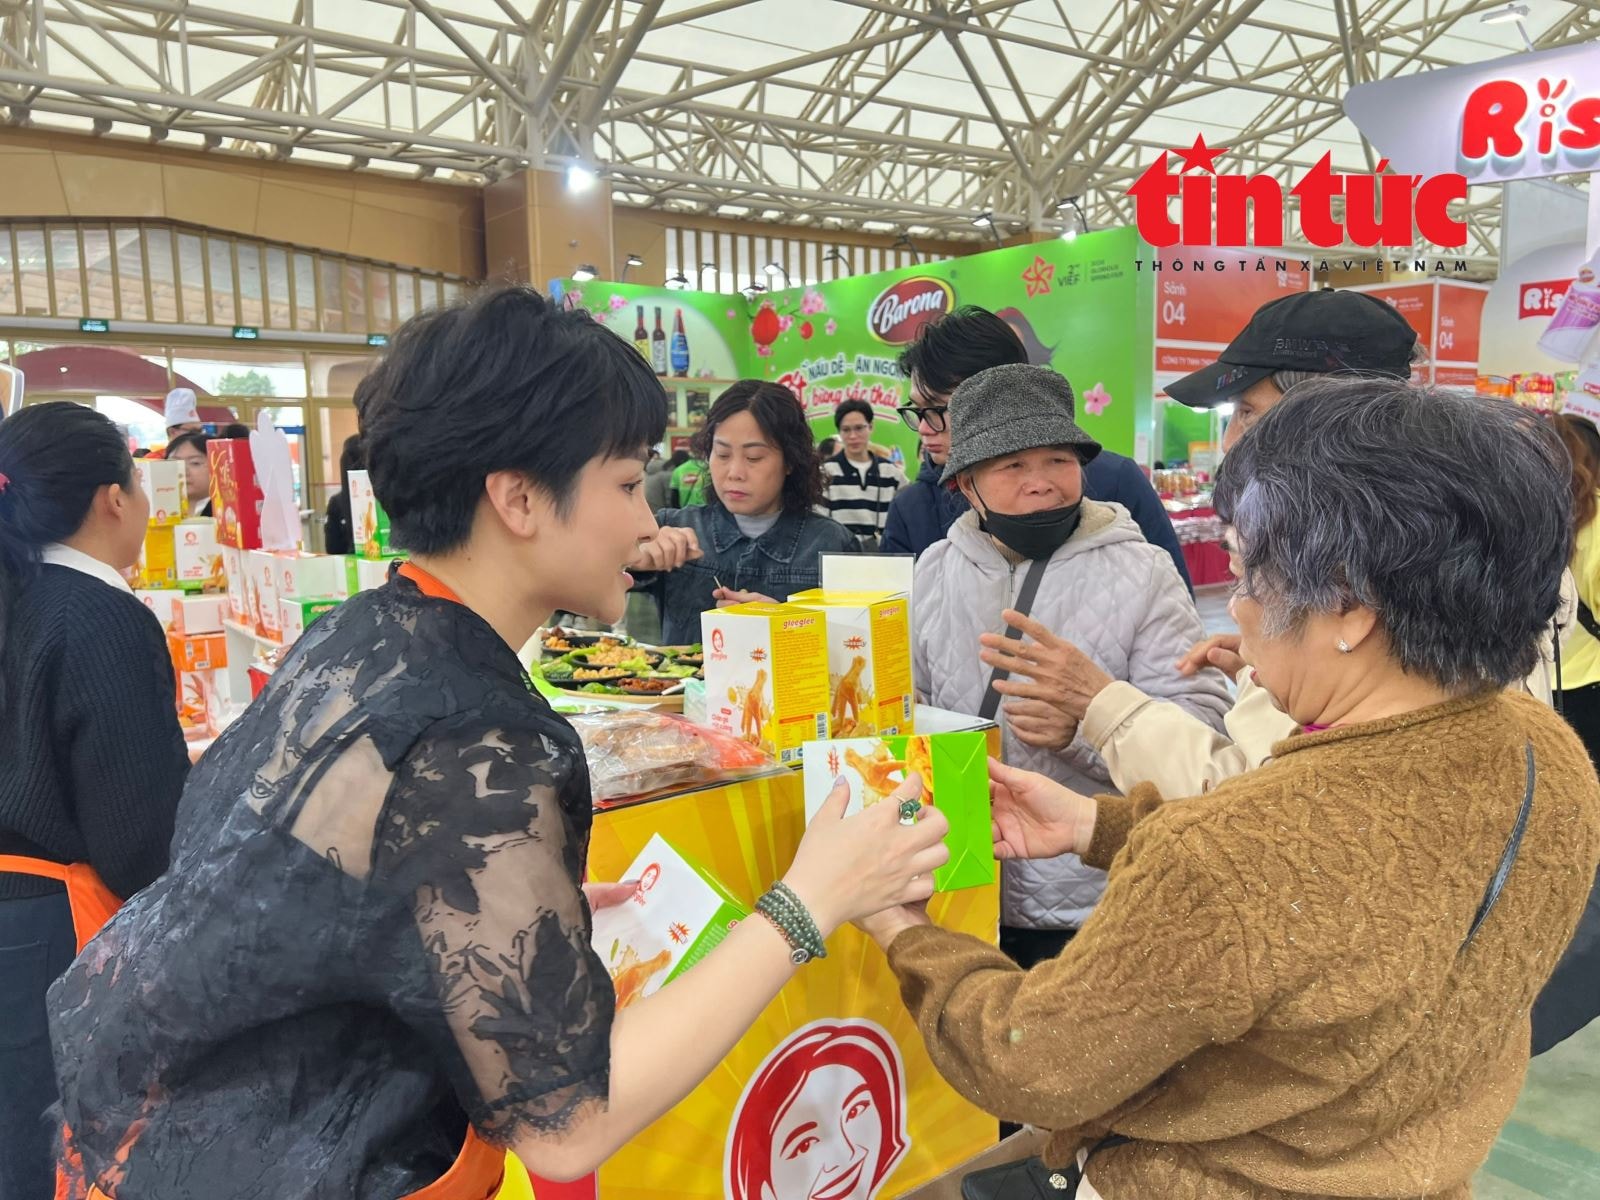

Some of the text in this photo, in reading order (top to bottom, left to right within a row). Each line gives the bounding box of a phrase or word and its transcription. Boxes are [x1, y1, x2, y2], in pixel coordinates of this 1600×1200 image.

[875, 291, 943, 333] Barona
[1162, 300, 1186, 326] 04
[1439, 331, 1453, 350] 04
[783, 617, 815, 629] gleeglee
